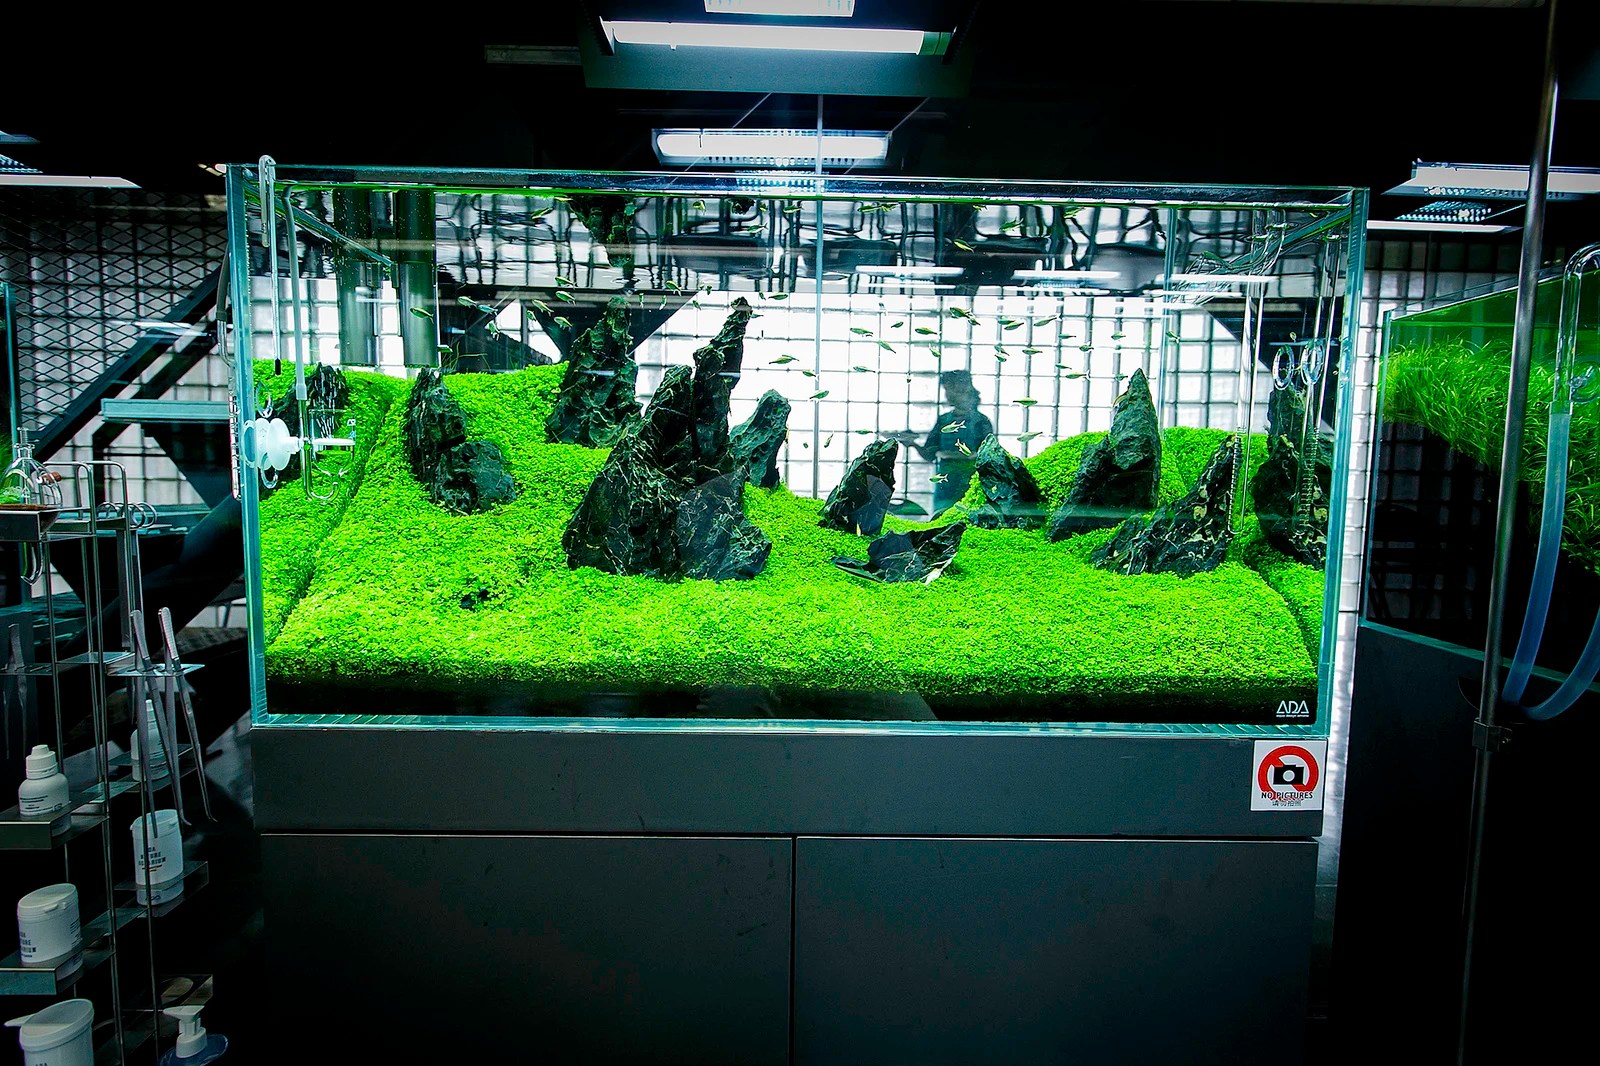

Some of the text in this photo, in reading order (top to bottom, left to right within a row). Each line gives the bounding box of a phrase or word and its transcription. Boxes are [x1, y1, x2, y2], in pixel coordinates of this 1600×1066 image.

[1276, 700, 1310, 714] ADA
[1261, 791, 1314, 799] NO PICTURES
